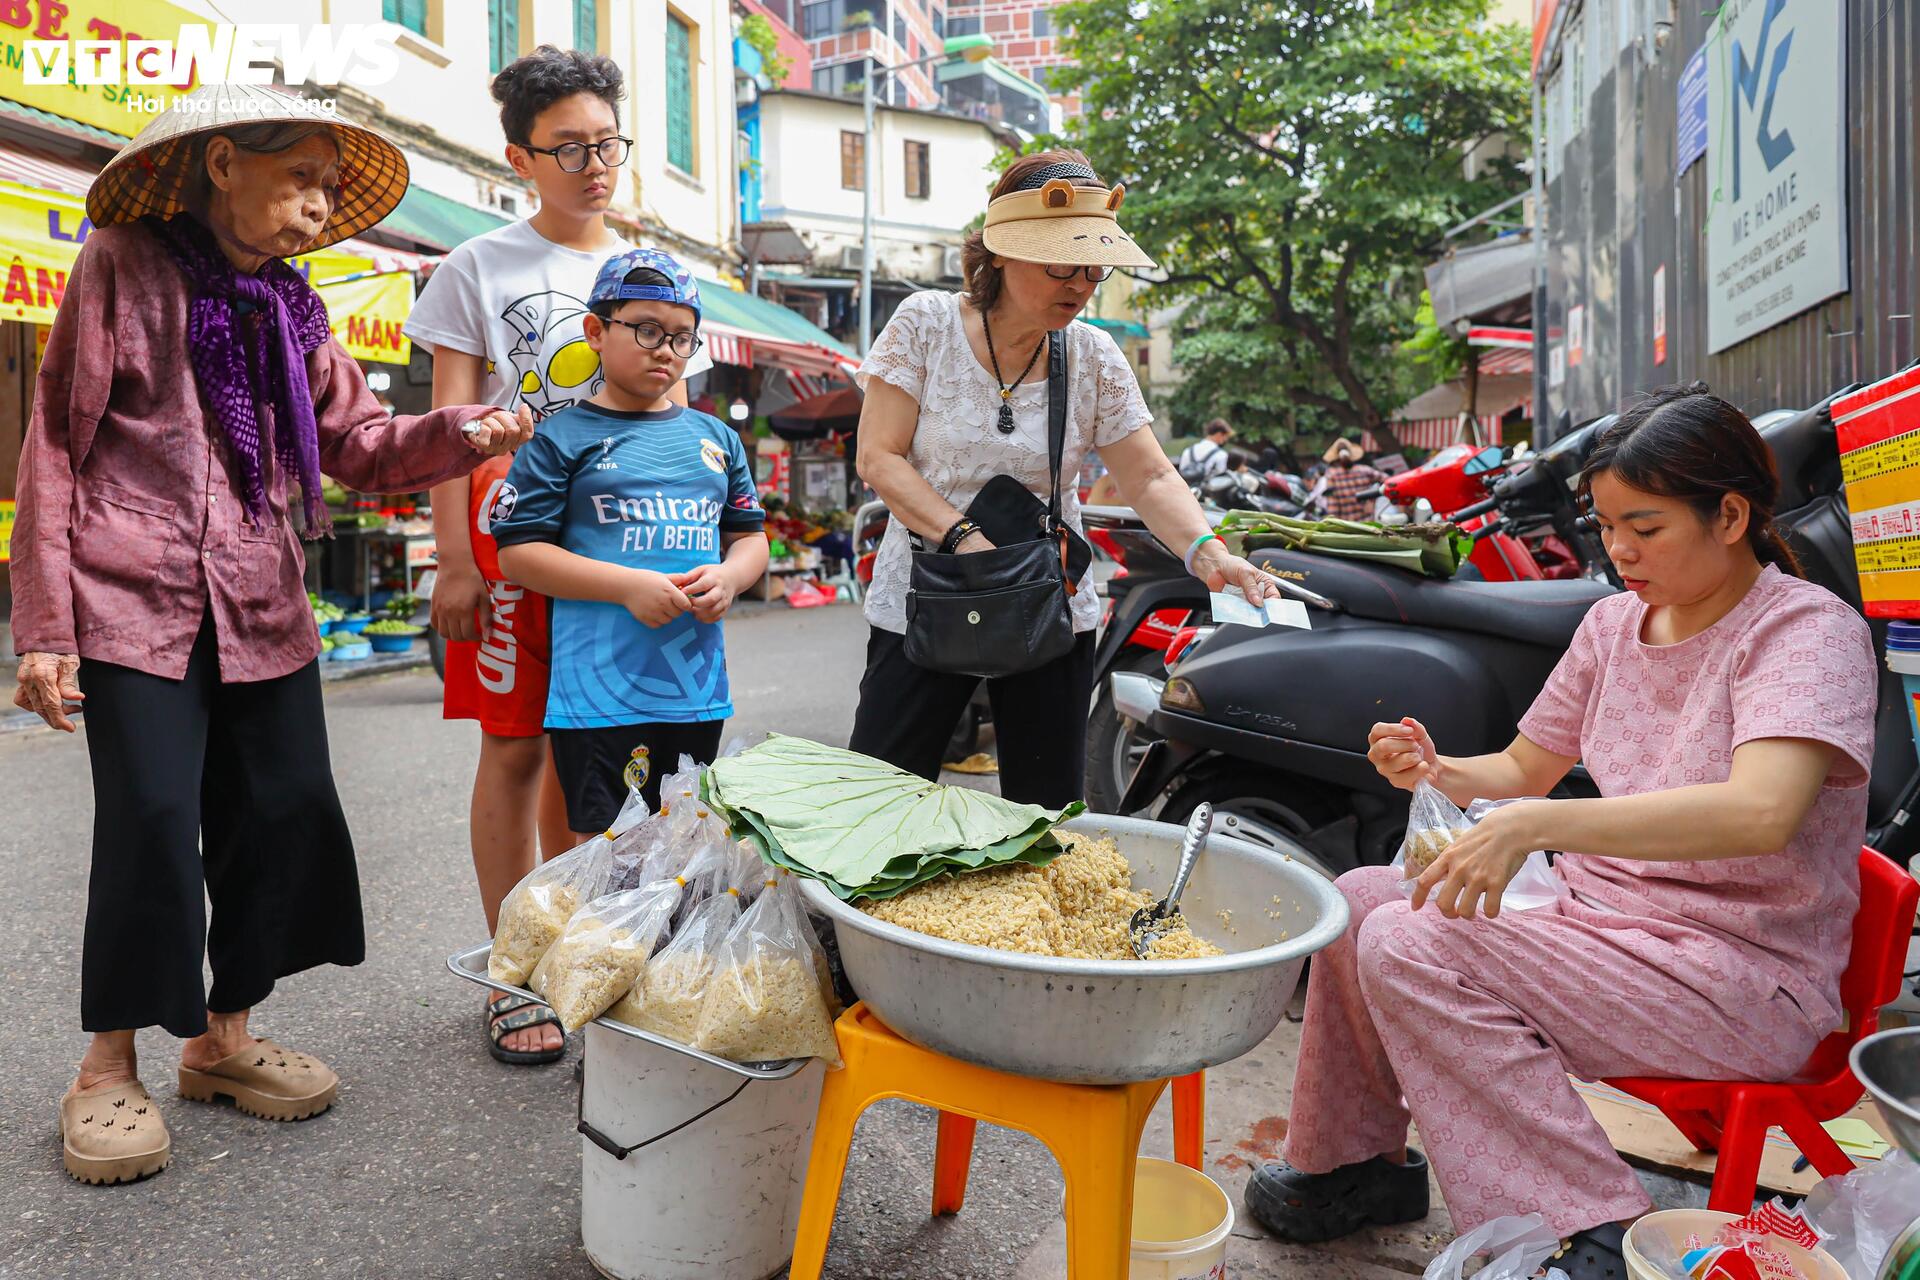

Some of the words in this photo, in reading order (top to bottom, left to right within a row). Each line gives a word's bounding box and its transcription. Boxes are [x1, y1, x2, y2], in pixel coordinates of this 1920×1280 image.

[1732, 210, 1749, 246] ME
[1755, 172, 1798, 229] HOME
[596, 462, 619, 470] FIFA
[590, 490, 724, 525] Emirates
[621, 525, 658, 552] FLY
[663, 525, 713, 552] BETTER
